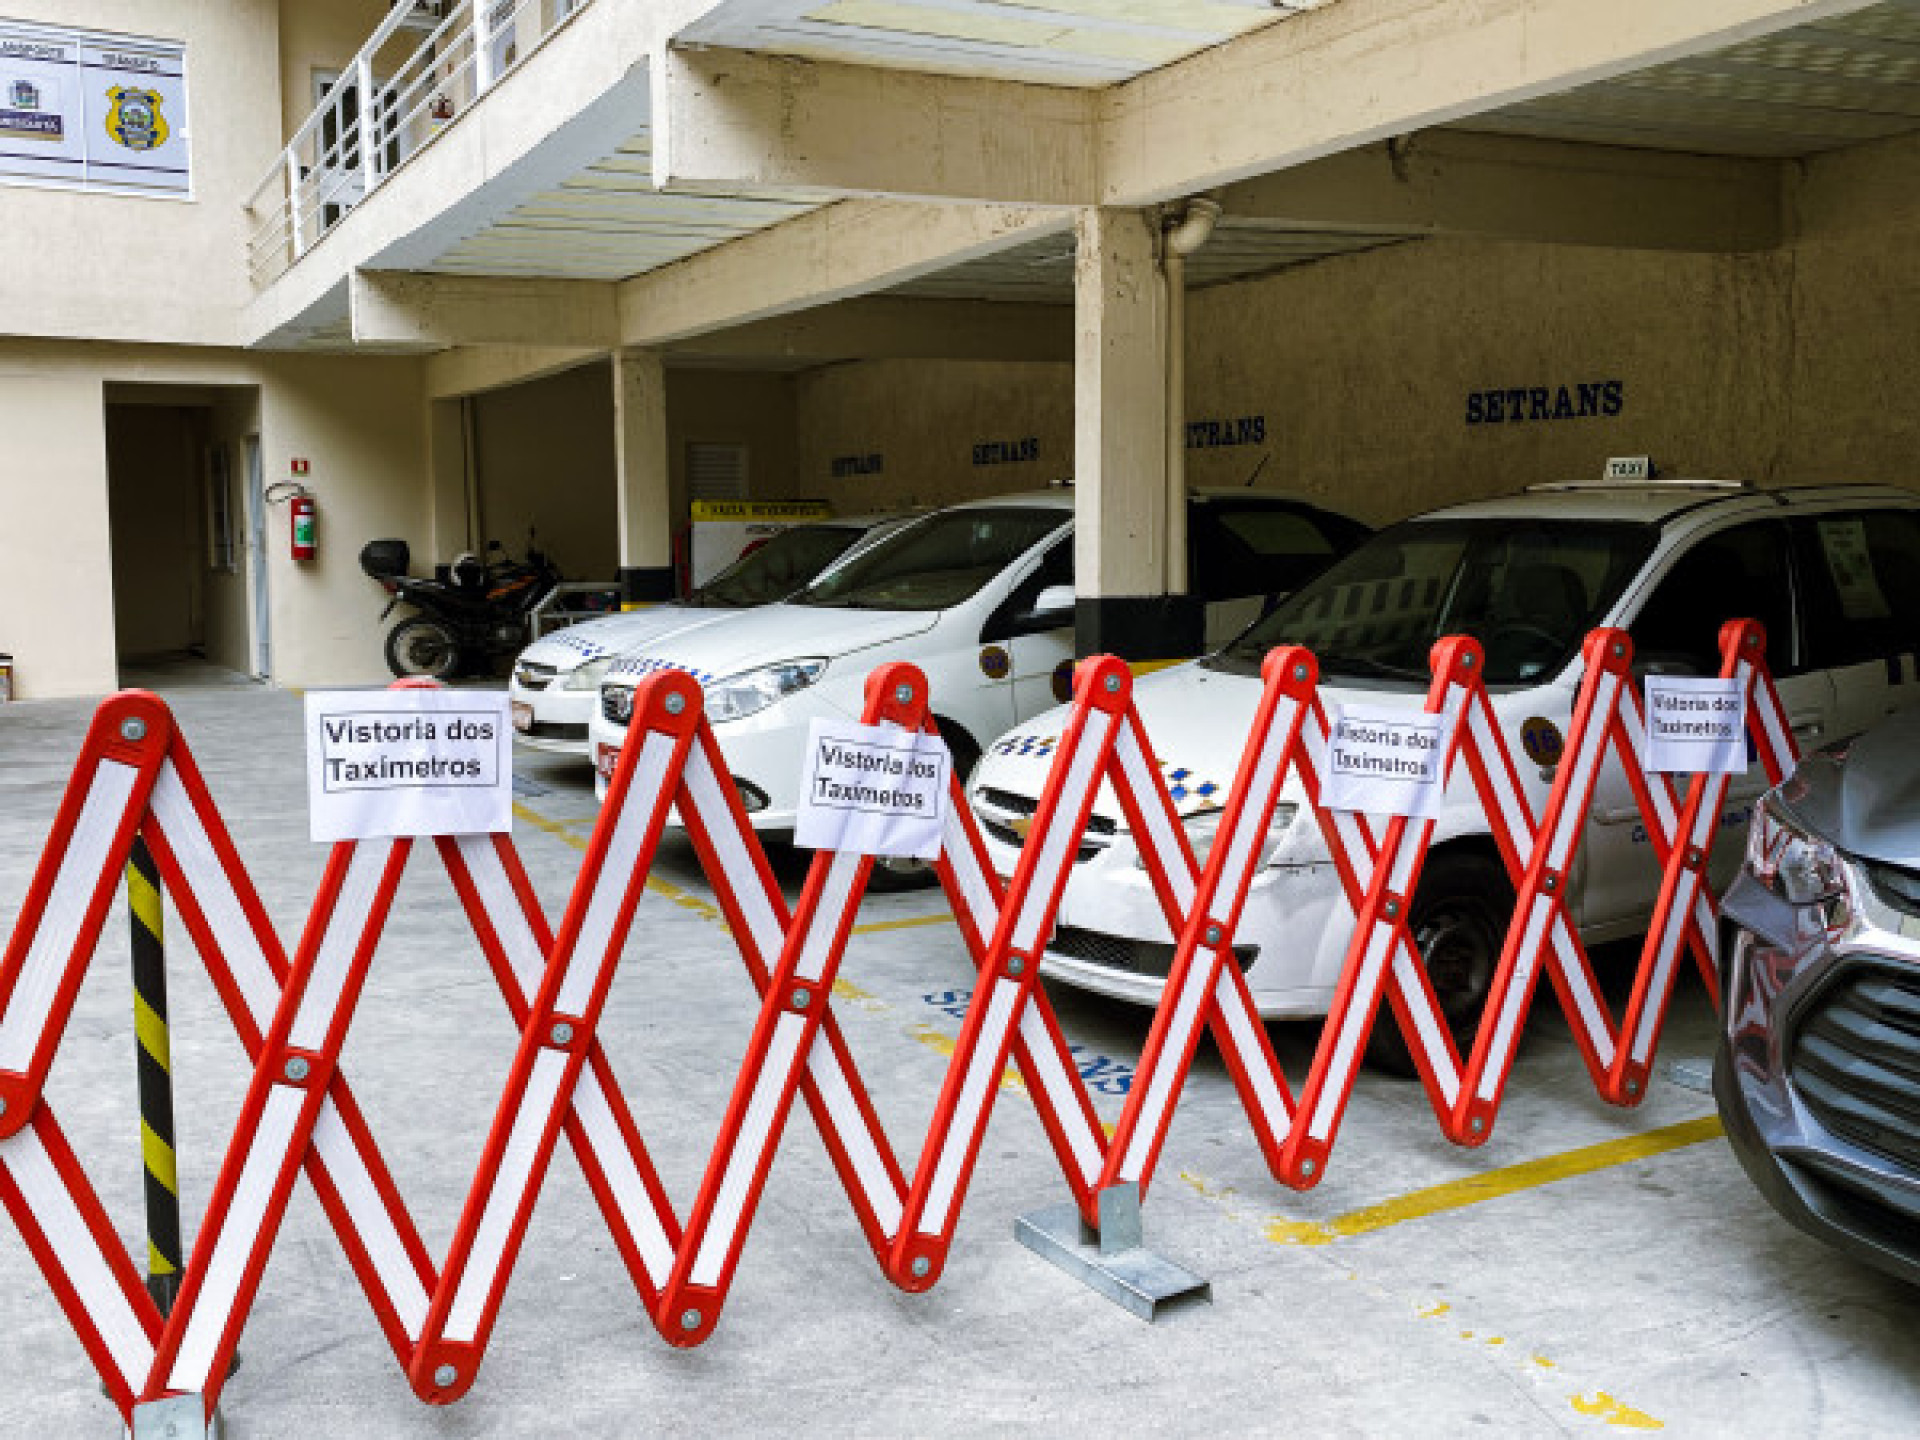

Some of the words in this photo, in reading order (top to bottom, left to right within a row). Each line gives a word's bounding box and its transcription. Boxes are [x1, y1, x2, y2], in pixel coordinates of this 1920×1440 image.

[1466, 381, 1624, 423] SETRANS
[1612, 463, 1643, 476] TAXI
[325, 716, 436, 743] Vistoria
[447, 716, 494, 740] dos
[1336, 723, 1401, 747] Vistoria
[1406, 732, 1438, 750] dos
[326, 755, 481, 781] Taxímetros
[821, 745, 903, 775] Vistoria
[906, 758, 935, 779] dos
